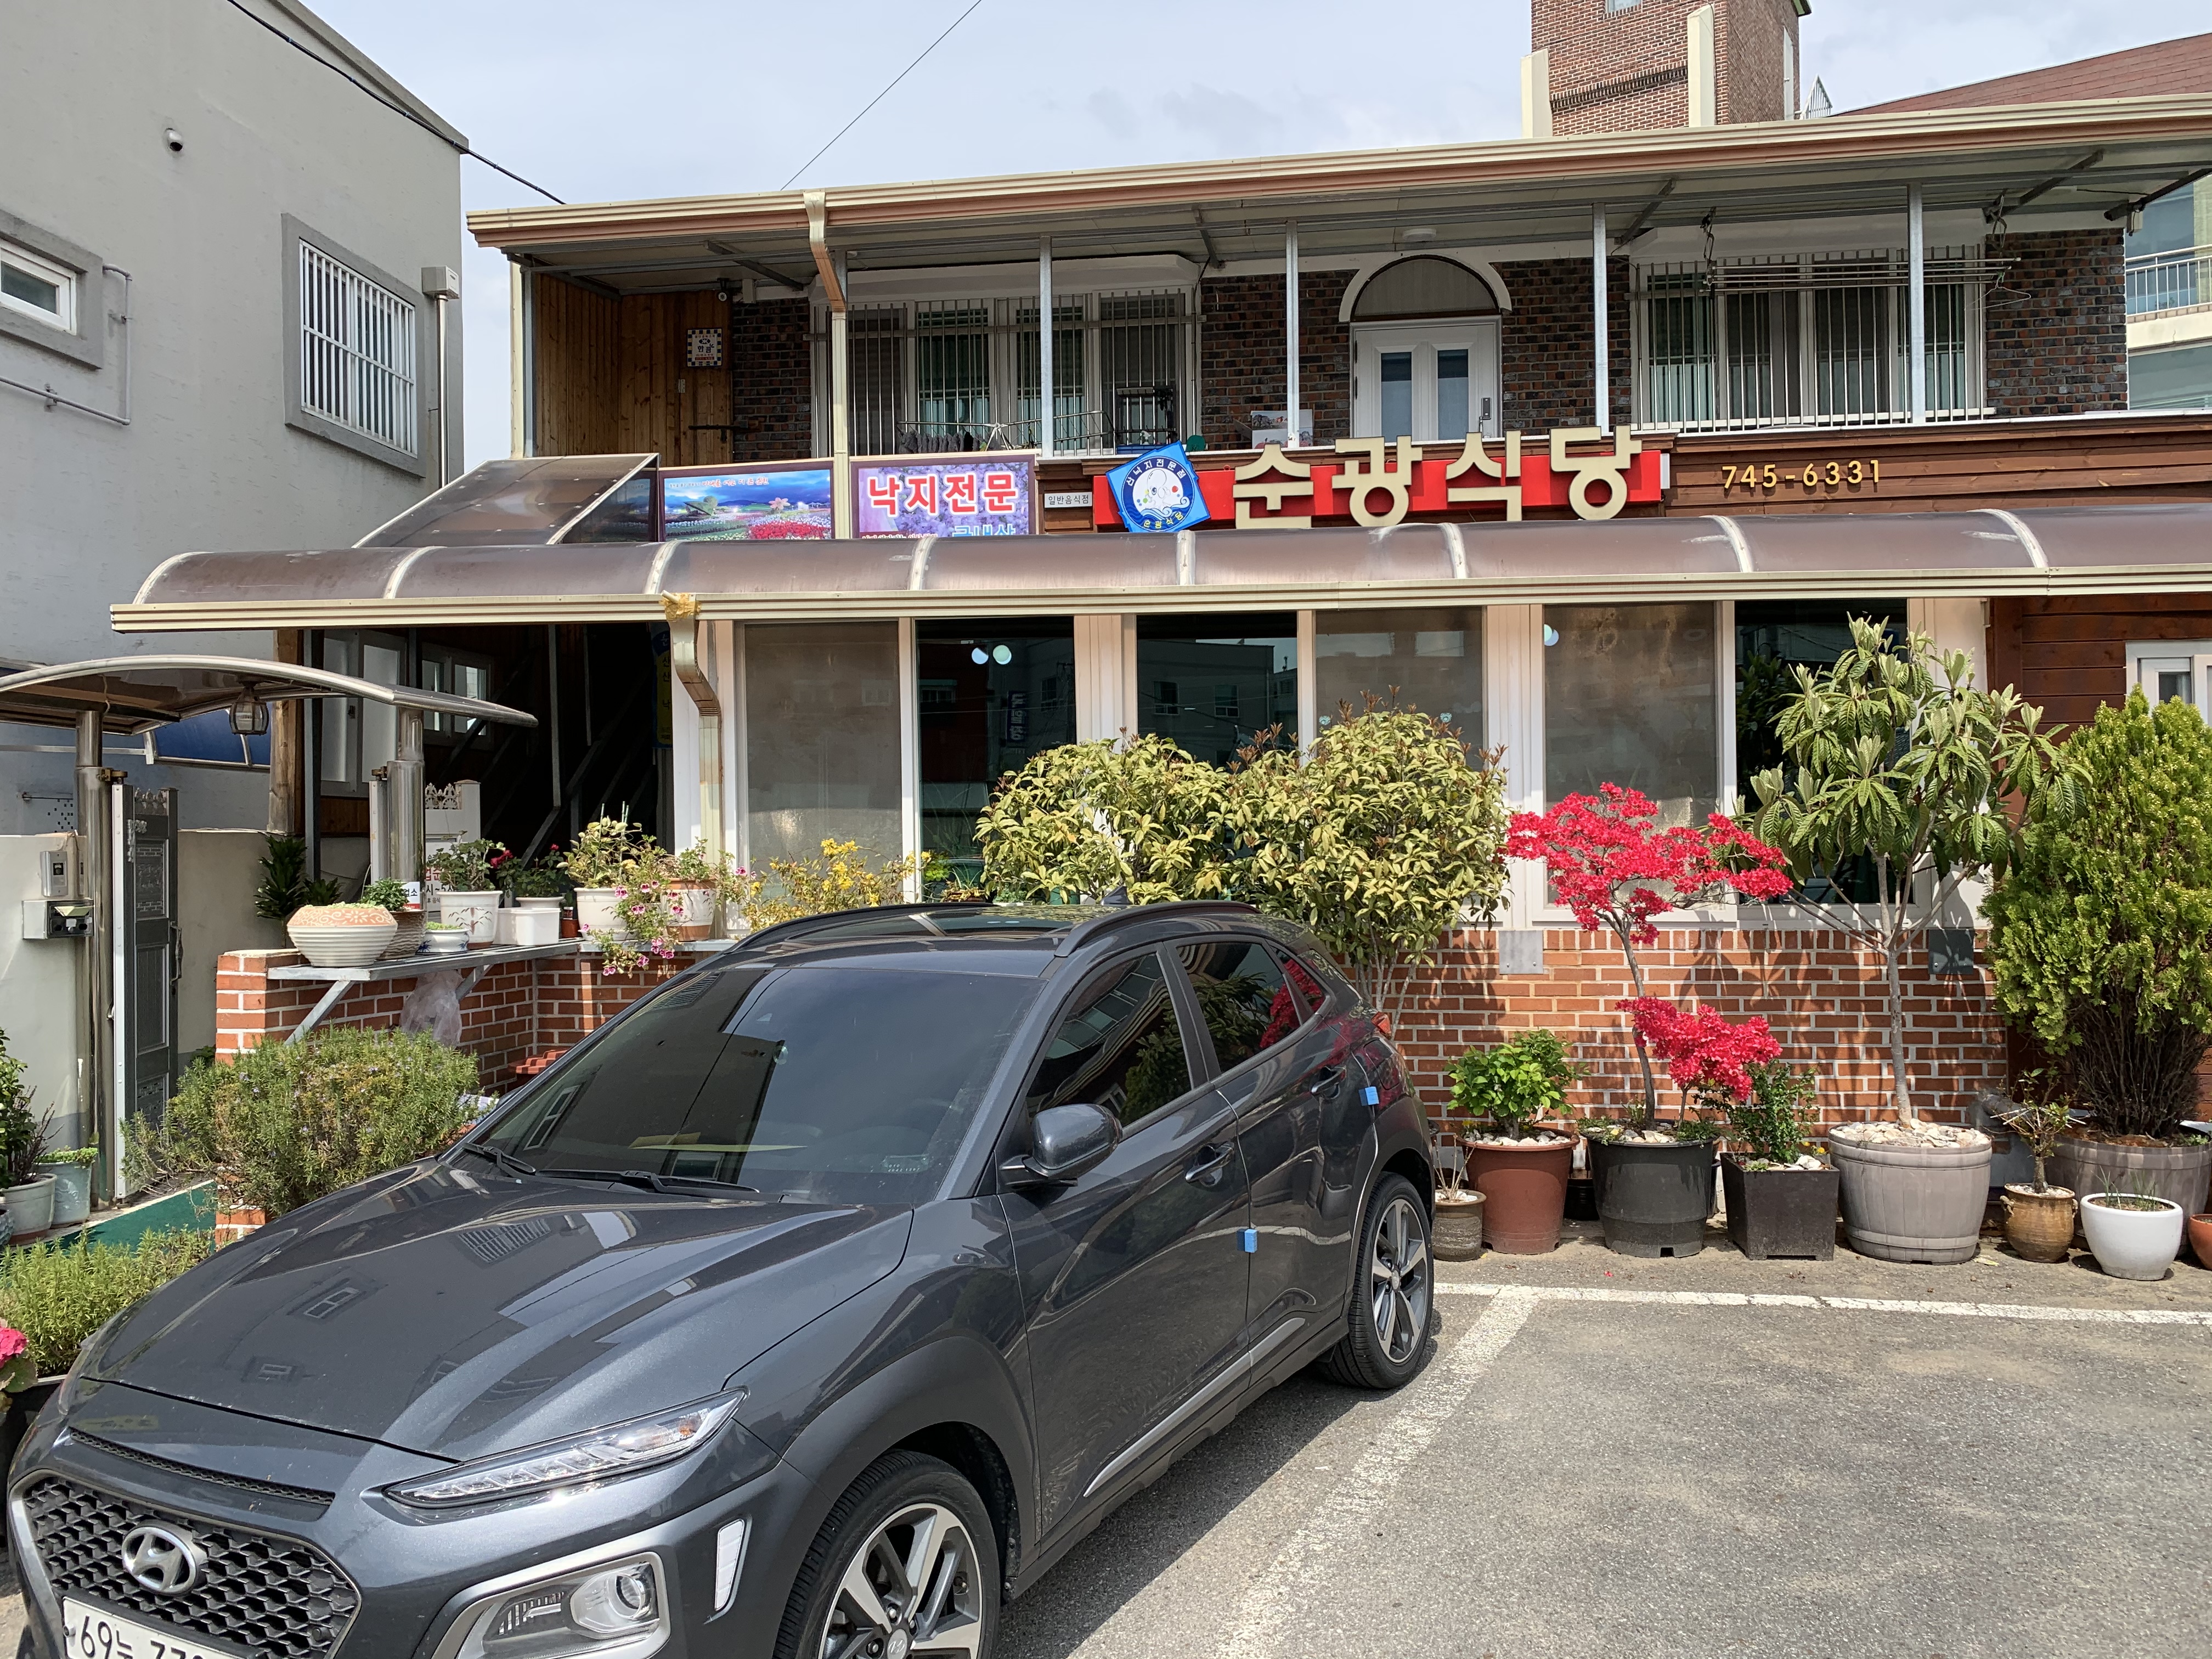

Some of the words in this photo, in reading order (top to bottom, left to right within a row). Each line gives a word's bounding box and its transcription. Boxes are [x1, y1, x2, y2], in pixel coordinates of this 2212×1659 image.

[1126, 459, 1186, 486] 산낙지전문점
[1233, 425, 1642, 528] 순광식당
[1722, 460, 1881, 489] 745-6331
[867, 471, 1019, 517] 낙지전문
[1048, 495, 1088, 505] 일반음식점
[1143, 511, 1183, 529] 순광식당
